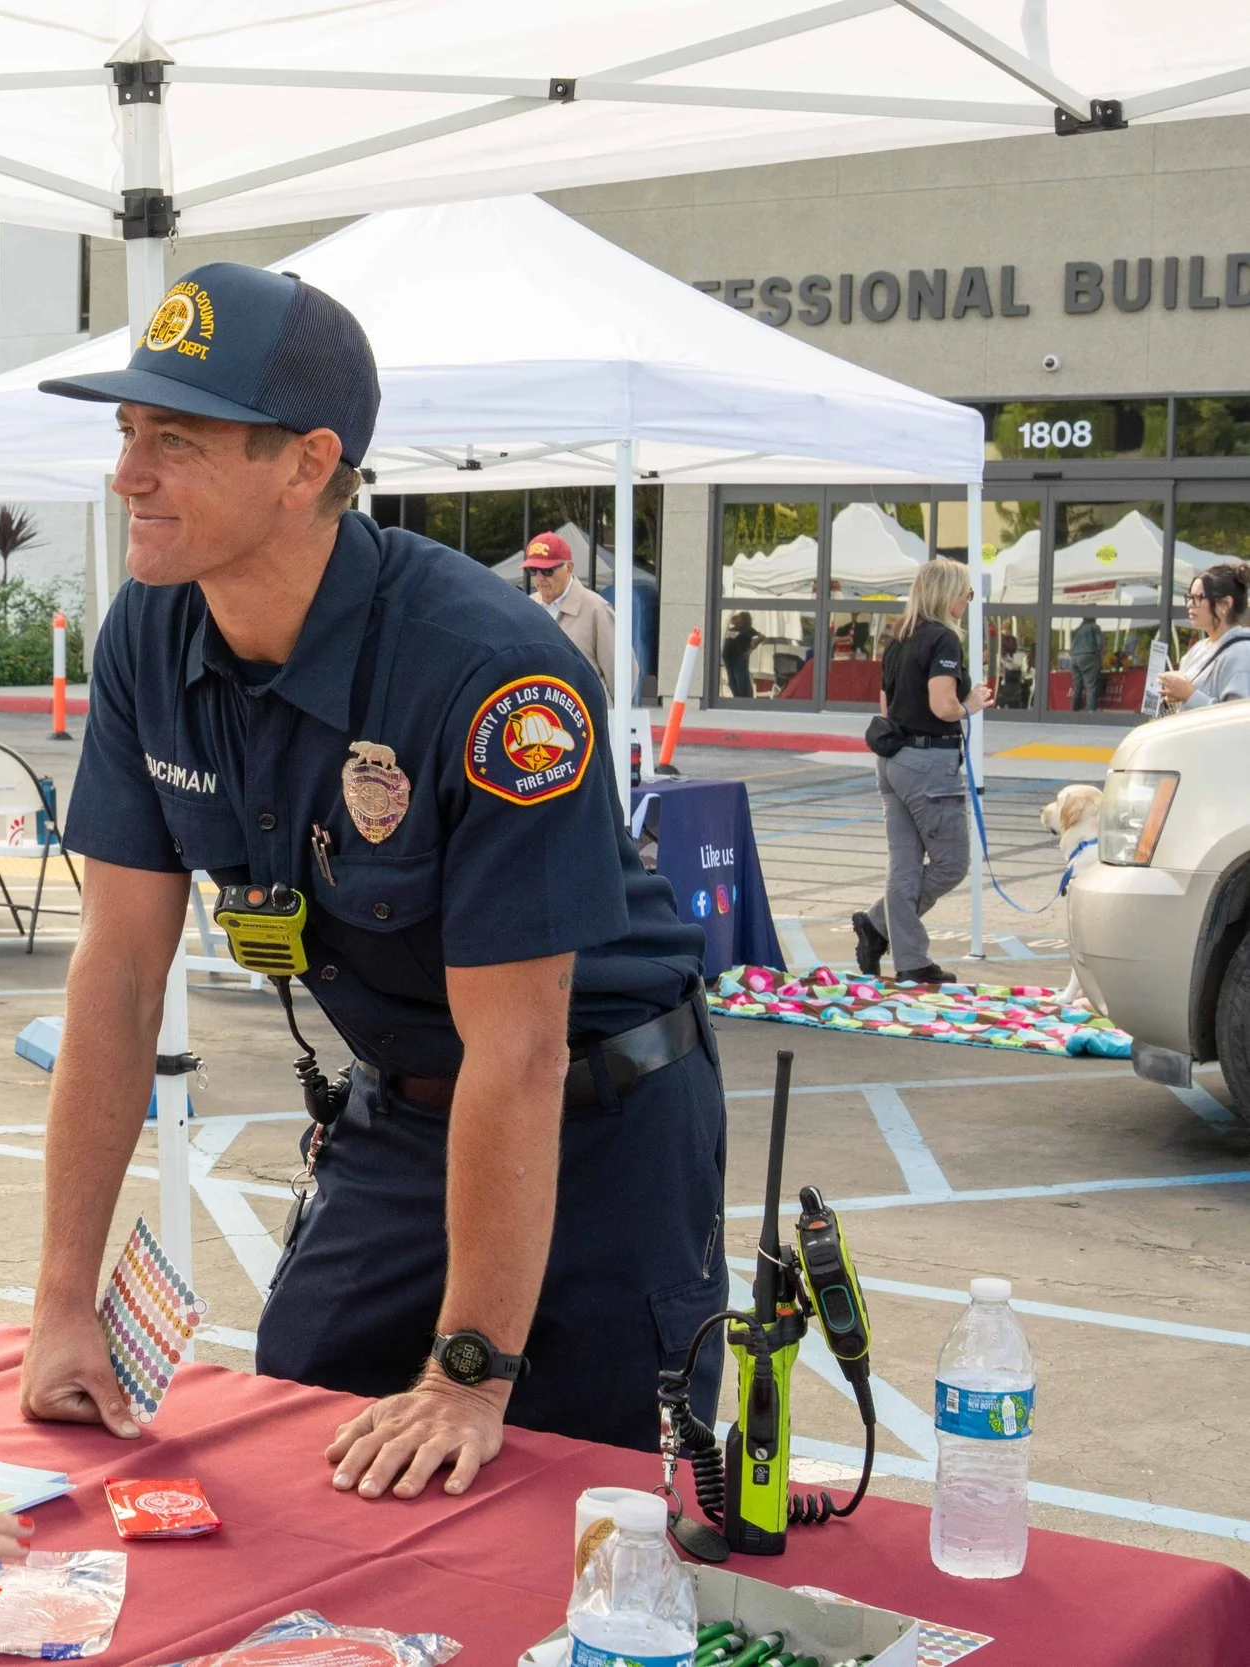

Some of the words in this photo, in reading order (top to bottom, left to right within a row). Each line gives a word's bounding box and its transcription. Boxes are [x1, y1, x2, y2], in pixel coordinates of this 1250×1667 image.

[1064, 253, 1250, 314] BUILD
[195, 290, 215, 340] COUNTY
[1018, 420, 1092, 448] 1808
[473, 712, 499, 763] COUNTY
[495, 697, 513, 715] OF
[515, 686, 540, 705] LOS
[544, 687, 586, 728] ANGELES
[515, 772, 545, 793] FIRE
[546, 761, 576, 782] DEPT.
[700, 844, 721, 869] Like
[722, 847, 734, 866] us
